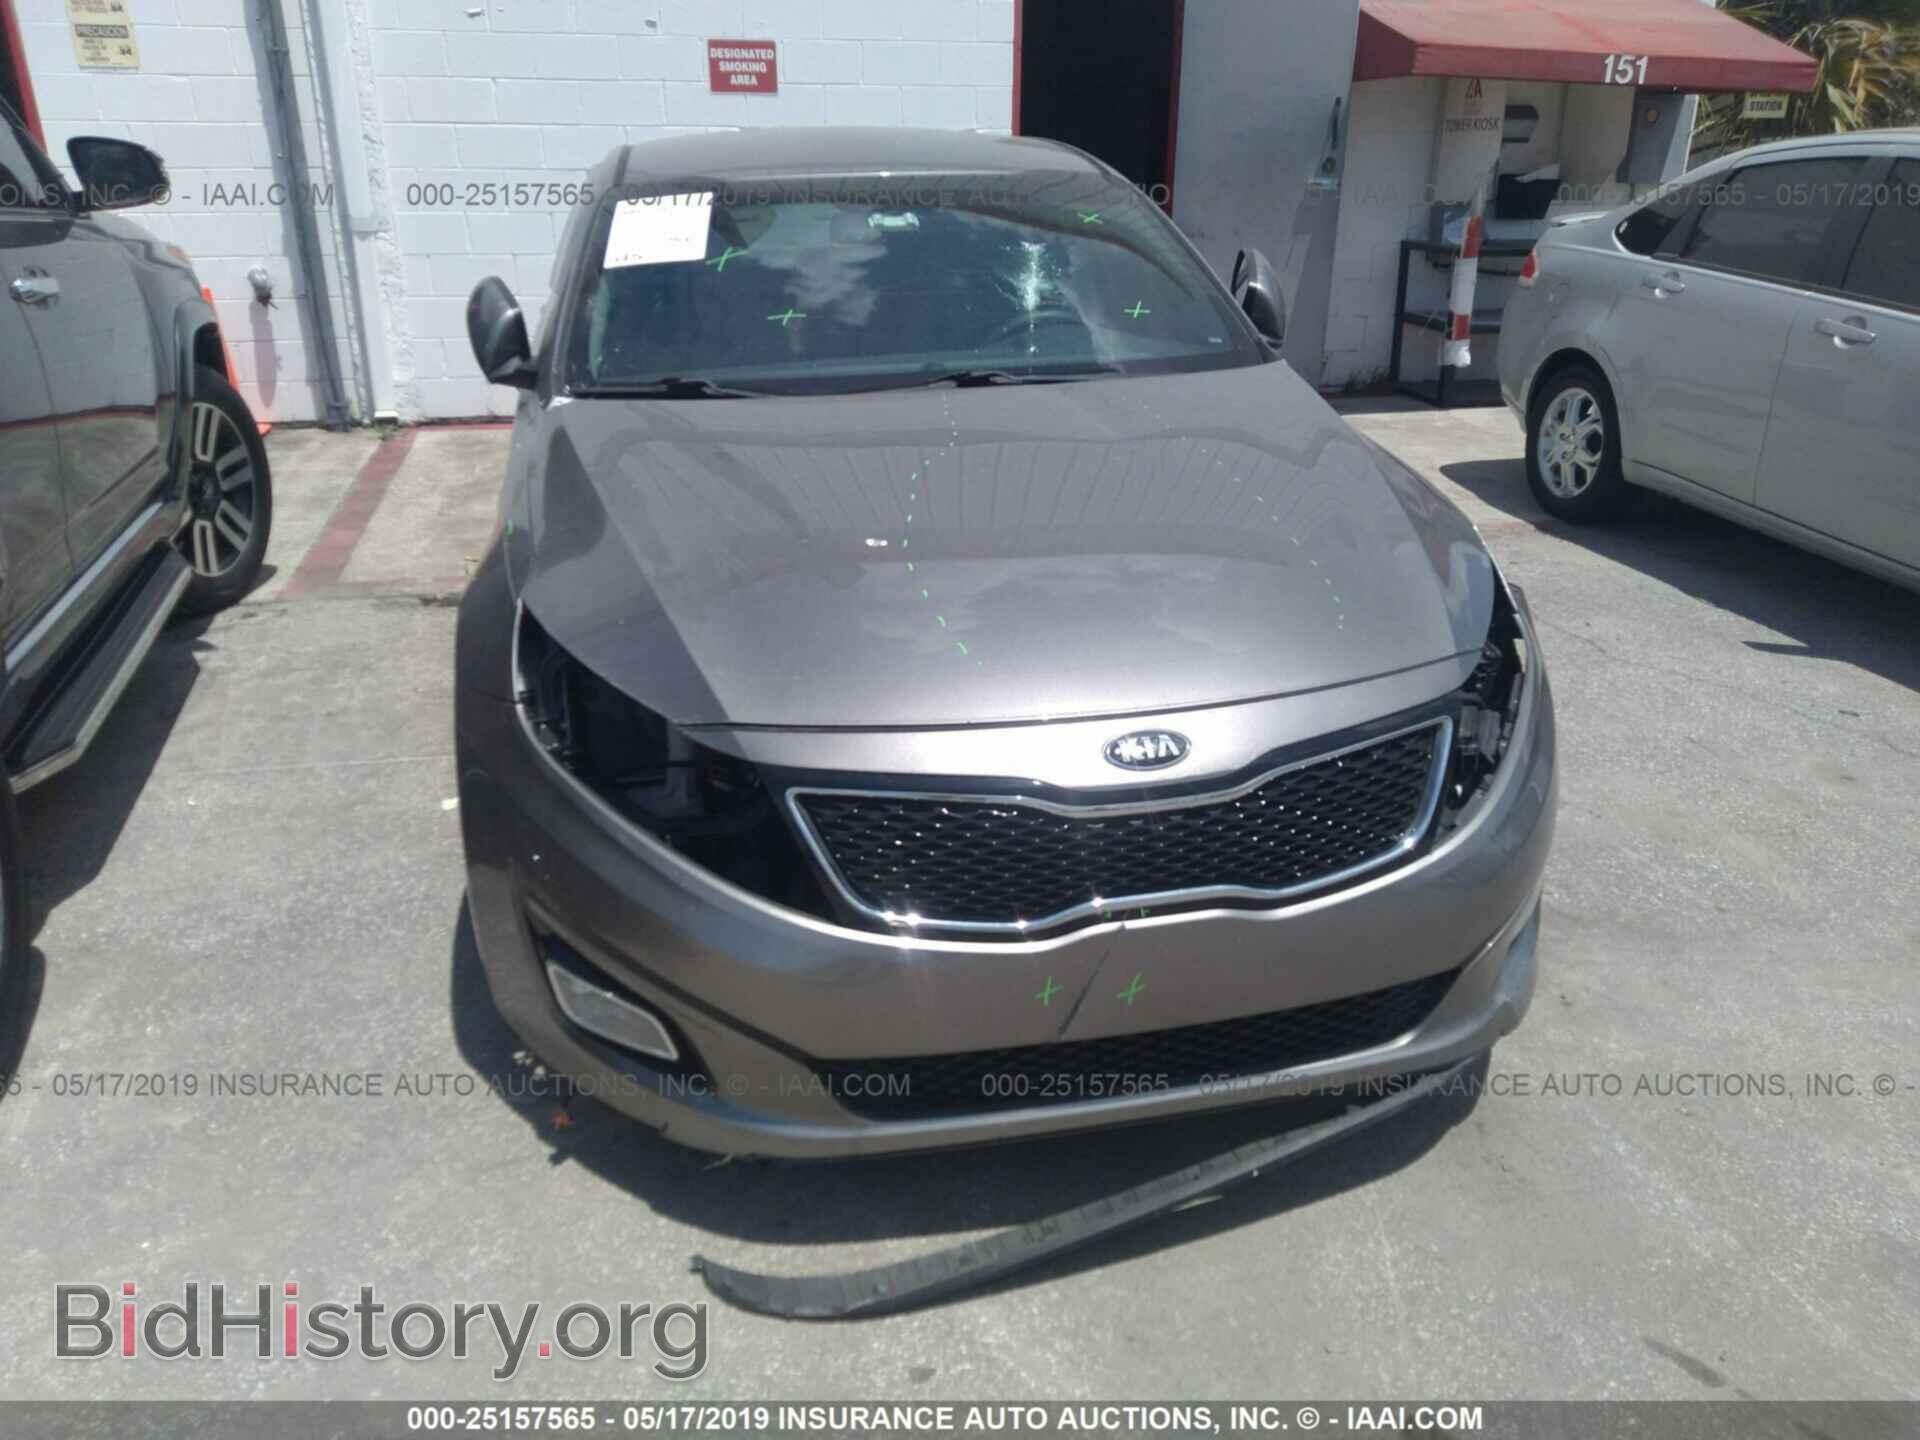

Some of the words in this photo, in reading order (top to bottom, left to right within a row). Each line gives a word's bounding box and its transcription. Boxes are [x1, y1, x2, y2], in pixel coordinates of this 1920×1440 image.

[710, 47, 774, 60] DESIGNATED
[719, 61, 767, 74] SMOKING
[1604, 54, 1649, 85] 151
[730, 74, 758, 86] AREA
[1114, 734, 1180, 762] KIA
